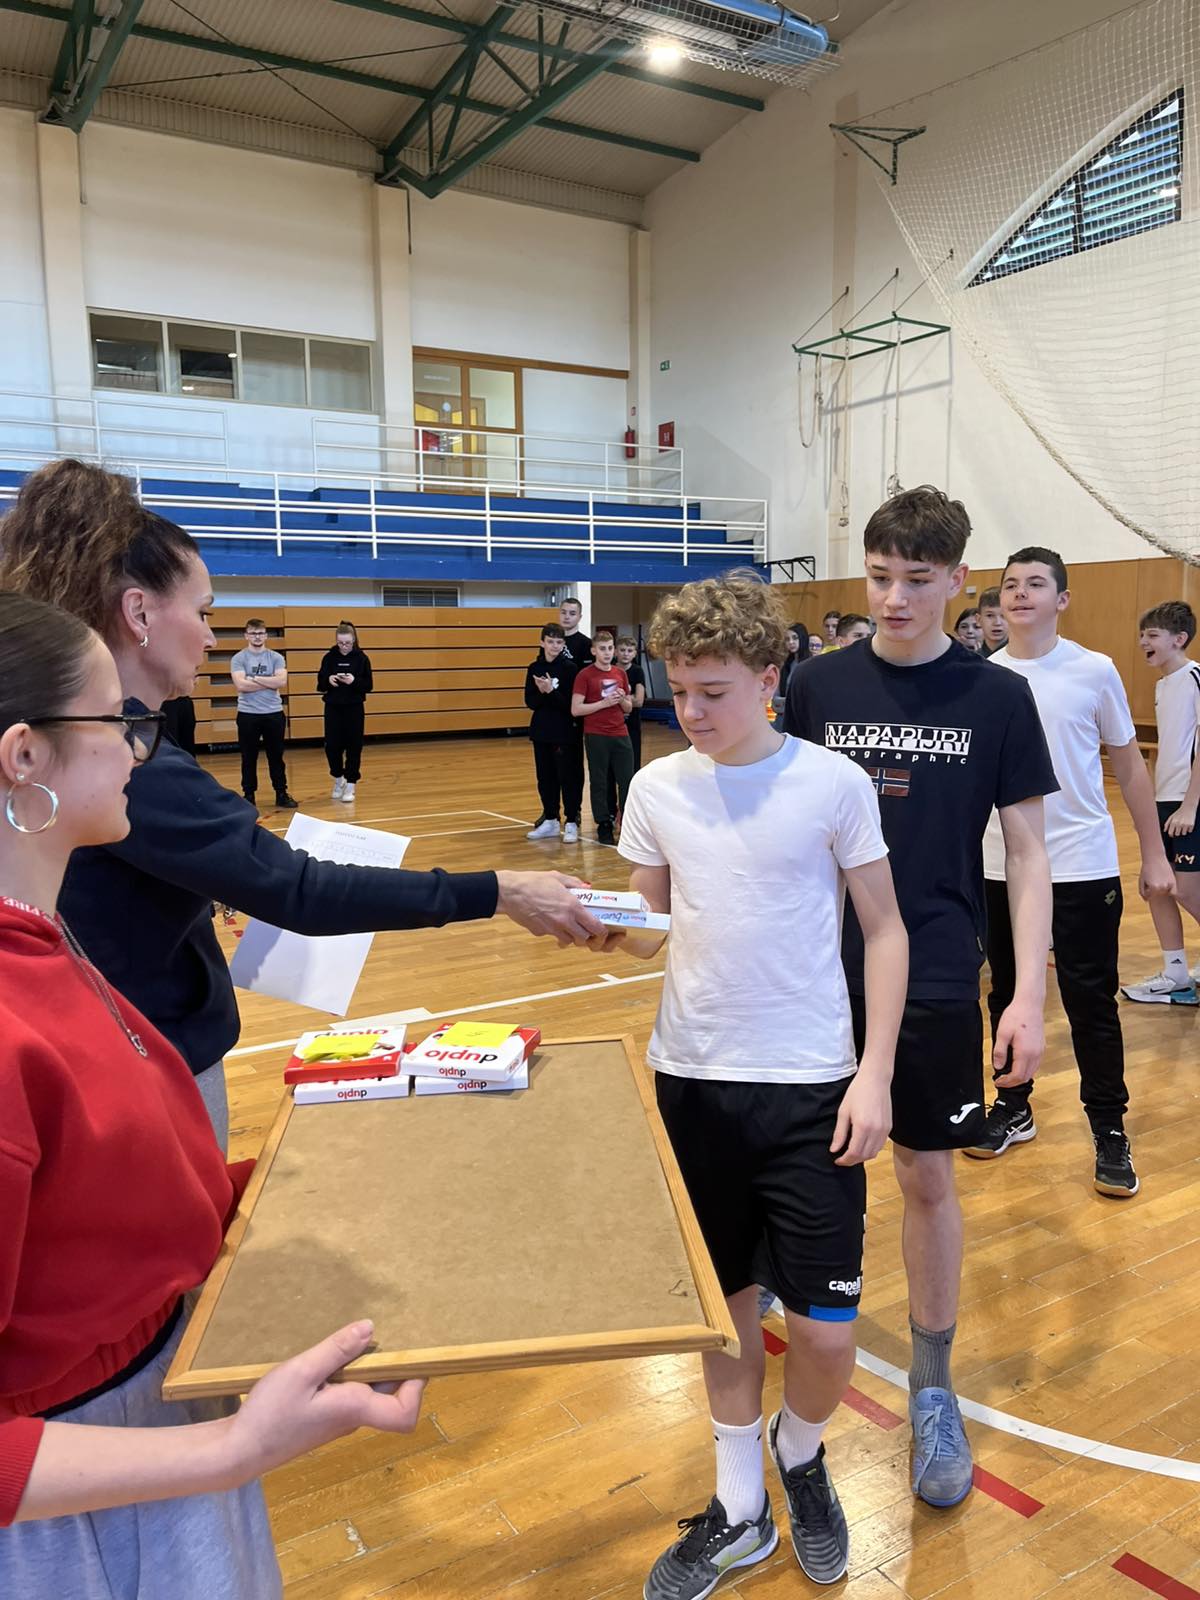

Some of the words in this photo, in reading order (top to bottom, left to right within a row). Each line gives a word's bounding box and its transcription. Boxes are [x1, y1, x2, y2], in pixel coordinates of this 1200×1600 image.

[826, 724, 969, 754] NAPAPIJRI
[837, 750, 966, 764] ographic
[424, 1049, 498, 1064] duplo
[438, 1066, 467, 1078] duplo
[457, 1079, 487, 1091] duplo
[337, 1088, 368, 1100] duplo
